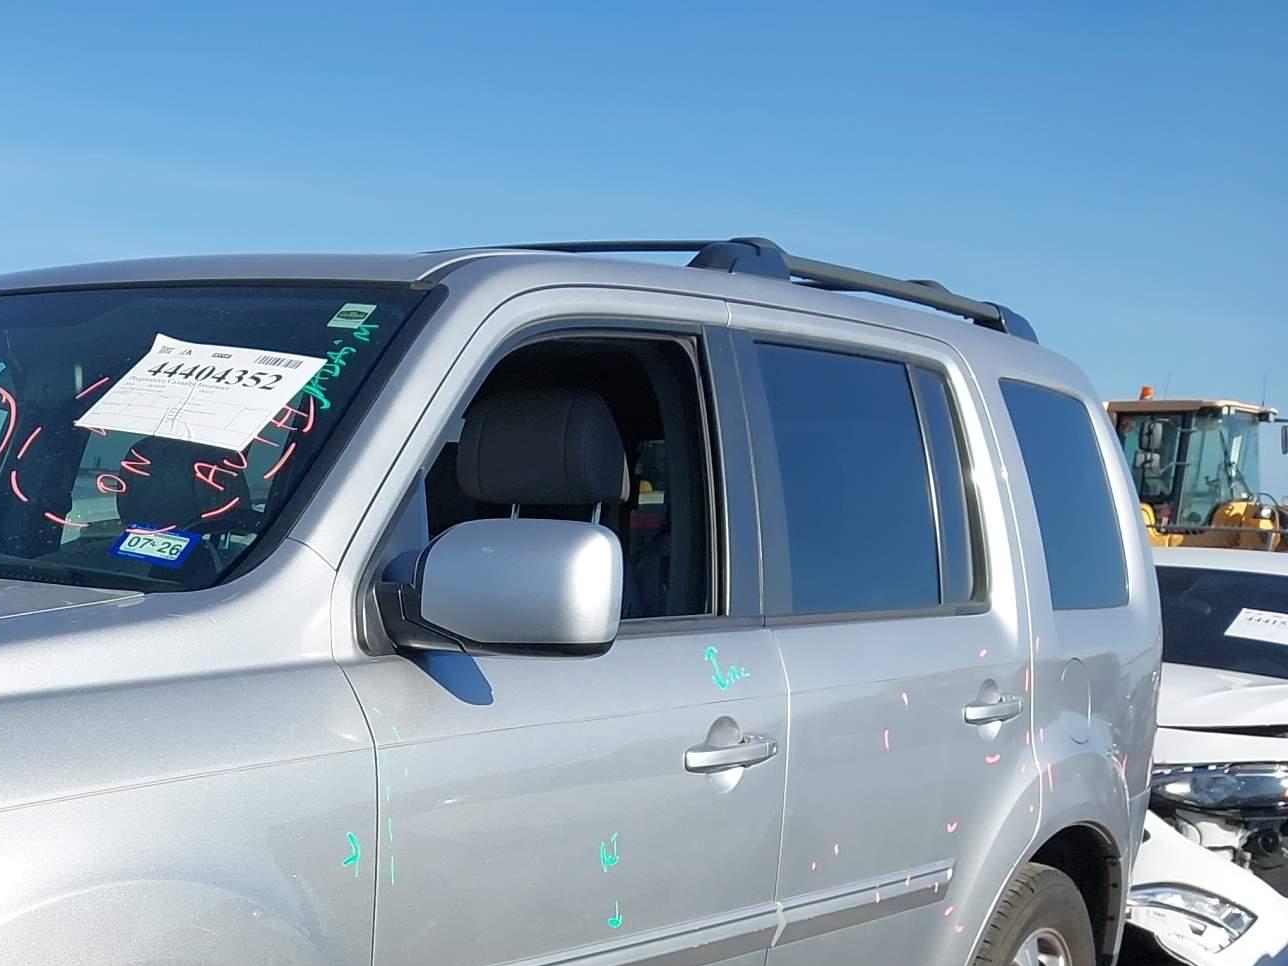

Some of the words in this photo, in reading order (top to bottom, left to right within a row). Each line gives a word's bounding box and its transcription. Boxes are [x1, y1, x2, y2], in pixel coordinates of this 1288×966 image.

[129, 375, 168, 385] Progressive
[198, 382, 231, 391] Insurance
[147, 360, 283, 391] 44404352
[96, 448, 153, 495] ON
[127, 536, 153, 549] 07
[157, 541, 182, 556] 26
